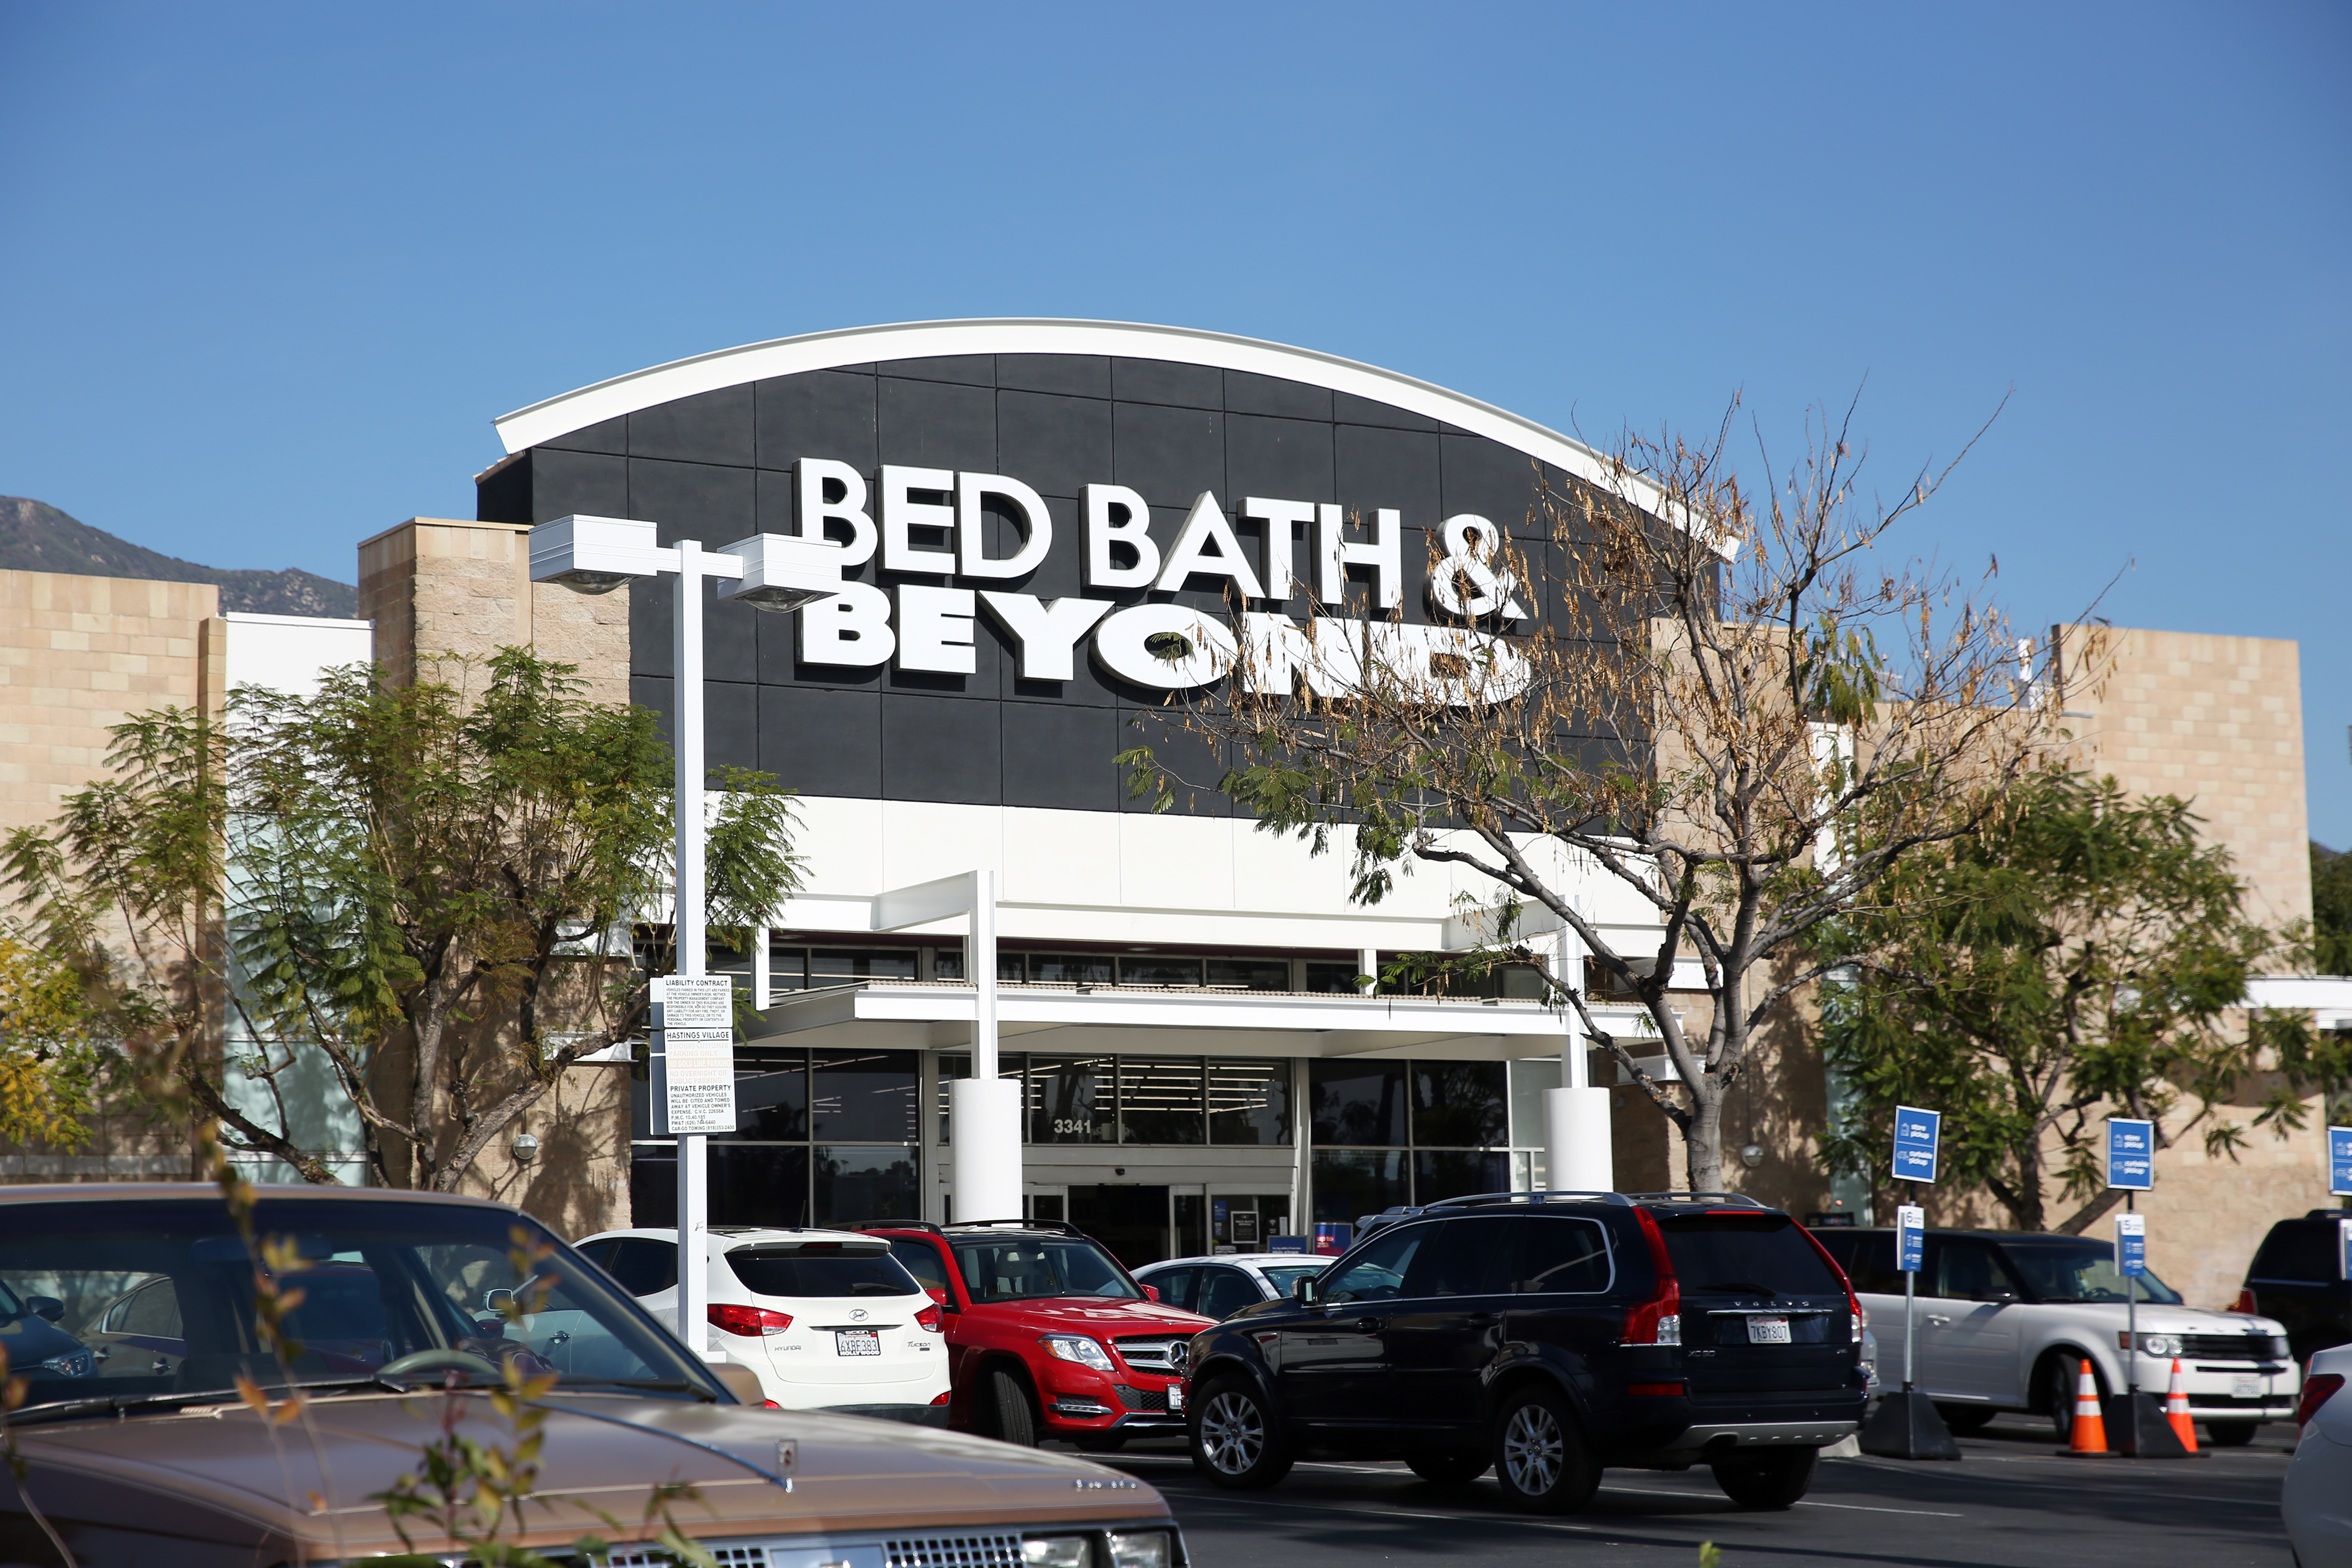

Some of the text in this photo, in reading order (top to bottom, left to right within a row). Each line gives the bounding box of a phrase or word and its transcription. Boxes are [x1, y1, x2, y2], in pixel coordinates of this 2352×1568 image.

[794, 457, 1528, 621] BED BATH &
[795, 580, 1532, 707] BEYOND
[1054, 1119, 1090, 1134] 3341
[1906, 1212, 1913, 1222] 6
[2123, 1220, 2131, 1230] 5
